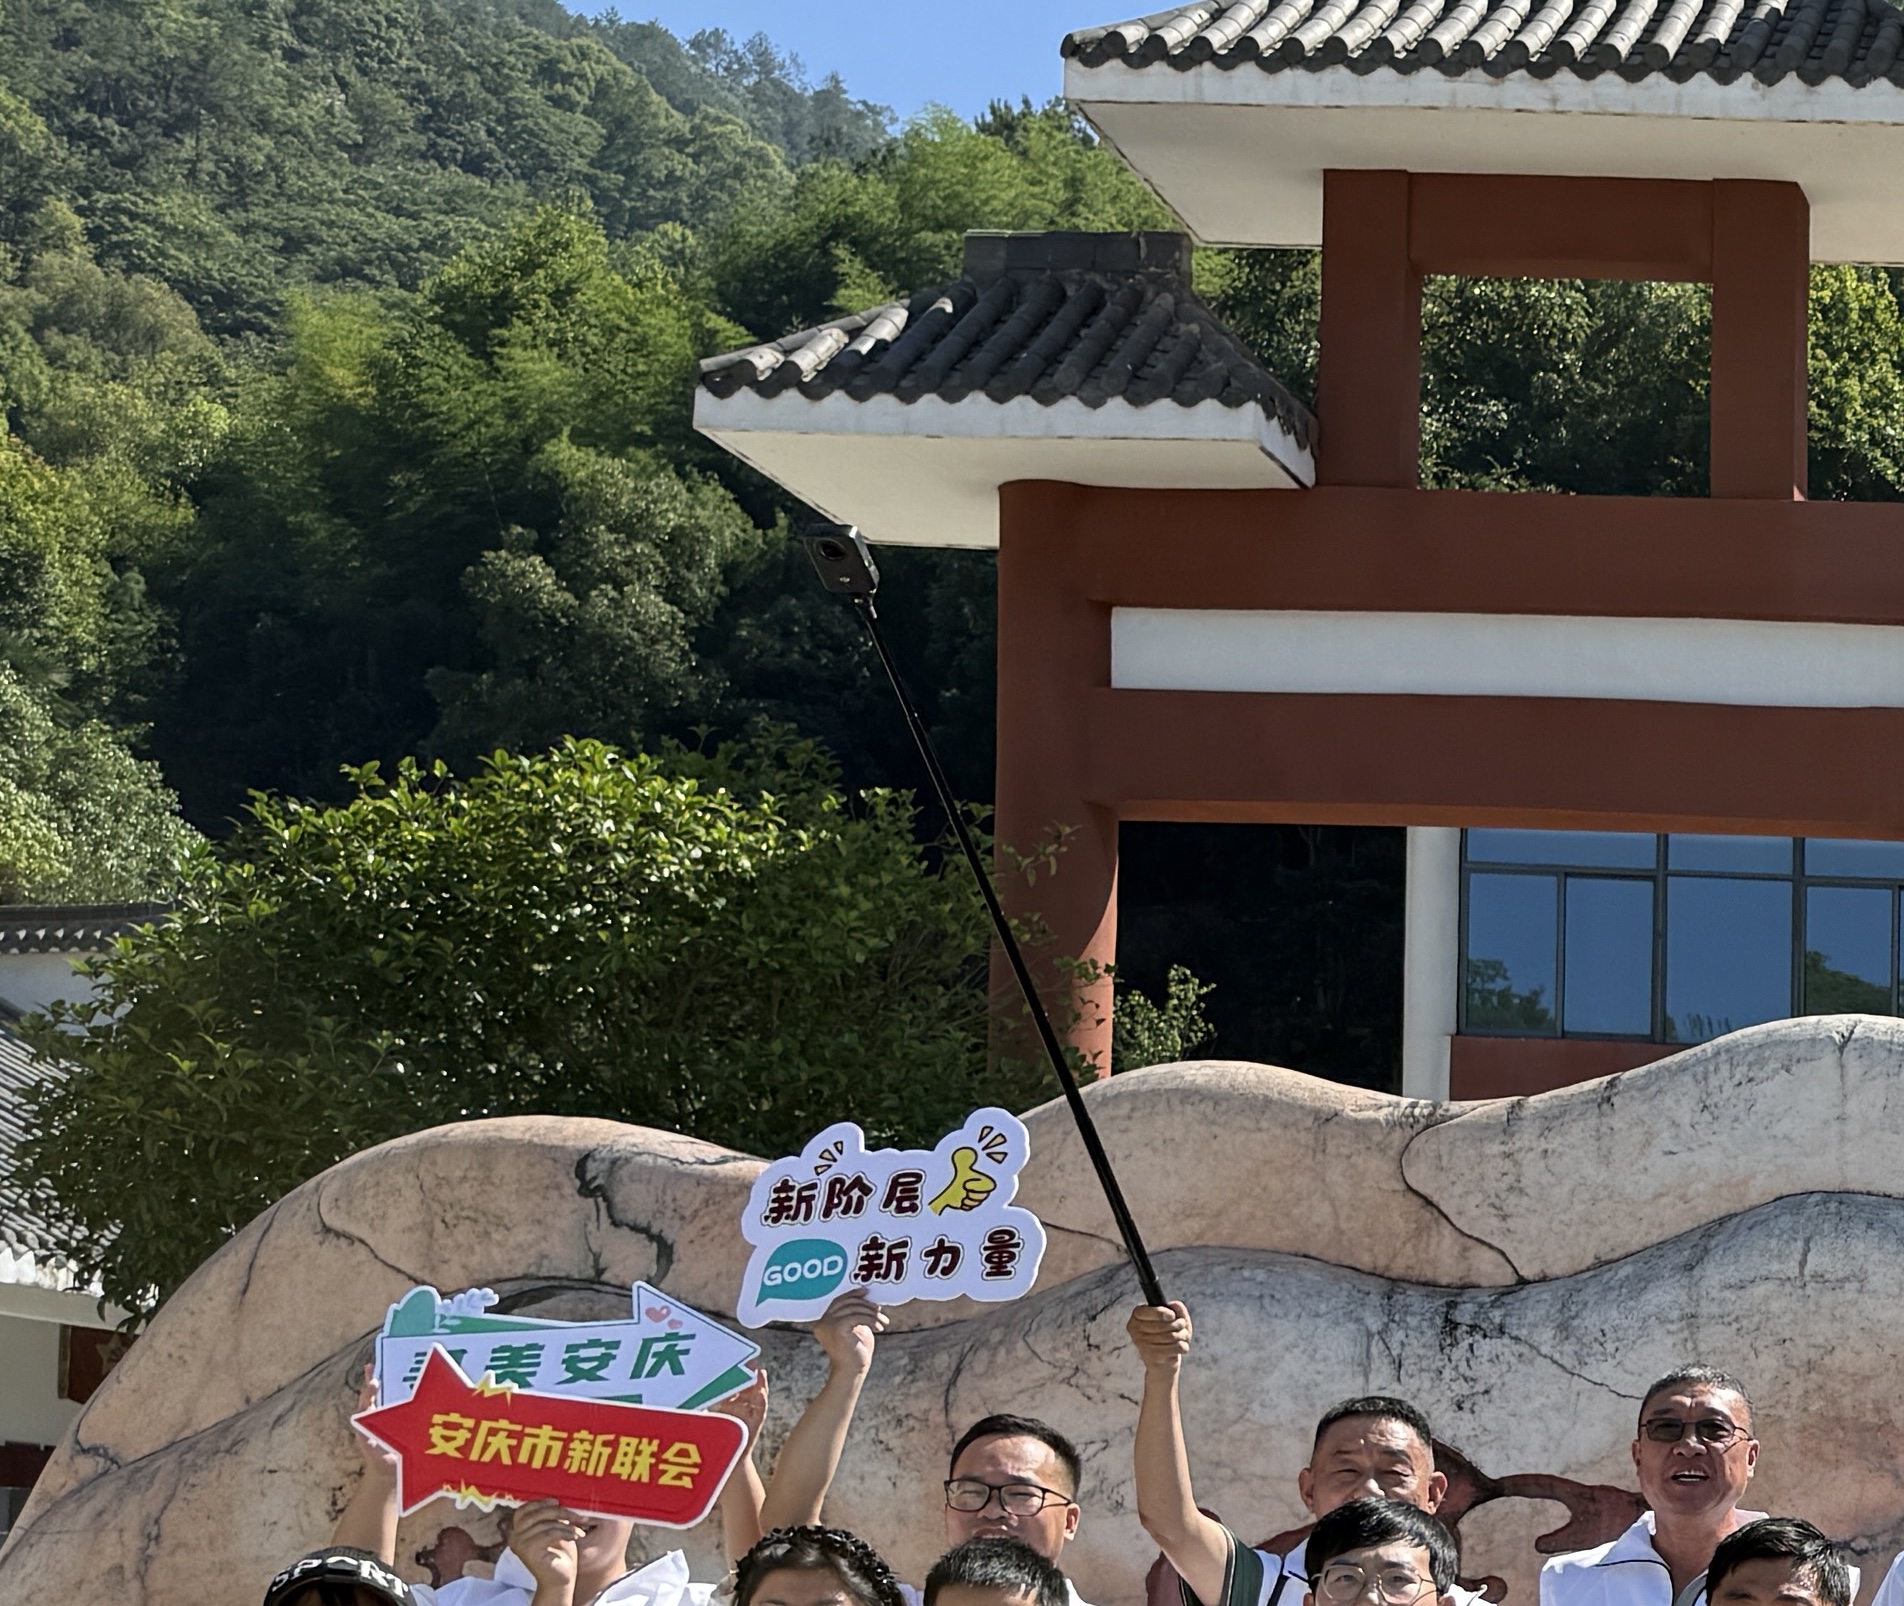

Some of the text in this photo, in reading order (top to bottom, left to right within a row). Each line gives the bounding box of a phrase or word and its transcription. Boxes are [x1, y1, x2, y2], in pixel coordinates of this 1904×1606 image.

[763, 1170, 925, 1226] 新阶层
[763, 1254, 844, 1287] GOOD
[851, 1226, 1024, 1284] 新力量
[425, 1411, 703, 1490] 安庆市新联会
